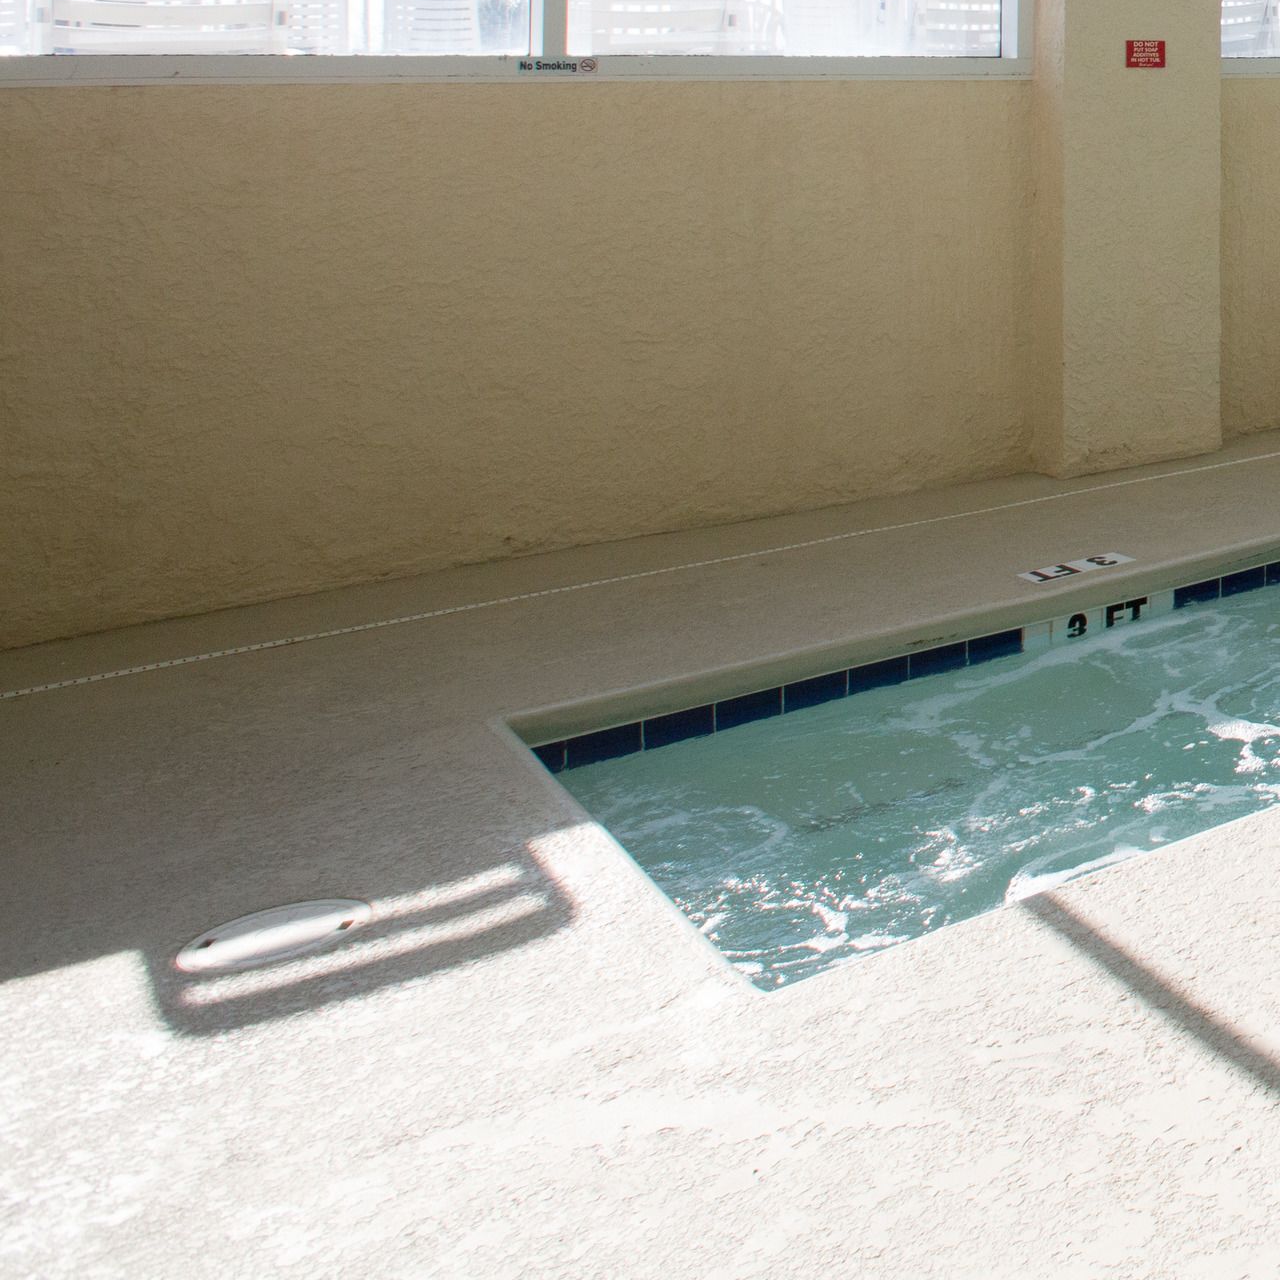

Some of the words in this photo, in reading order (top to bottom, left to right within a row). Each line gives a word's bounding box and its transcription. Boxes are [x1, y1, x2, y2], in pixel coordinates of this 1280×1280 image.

[519, 61, 533, 71] No
[535, 61, 577, 72] Smoking
[1086, 556, 1118, 566] 3
[1029, 564, 1082, 582] FT
[1066, 613, 1088, 638] 3
[1105, 596, 1148, 629] FT
